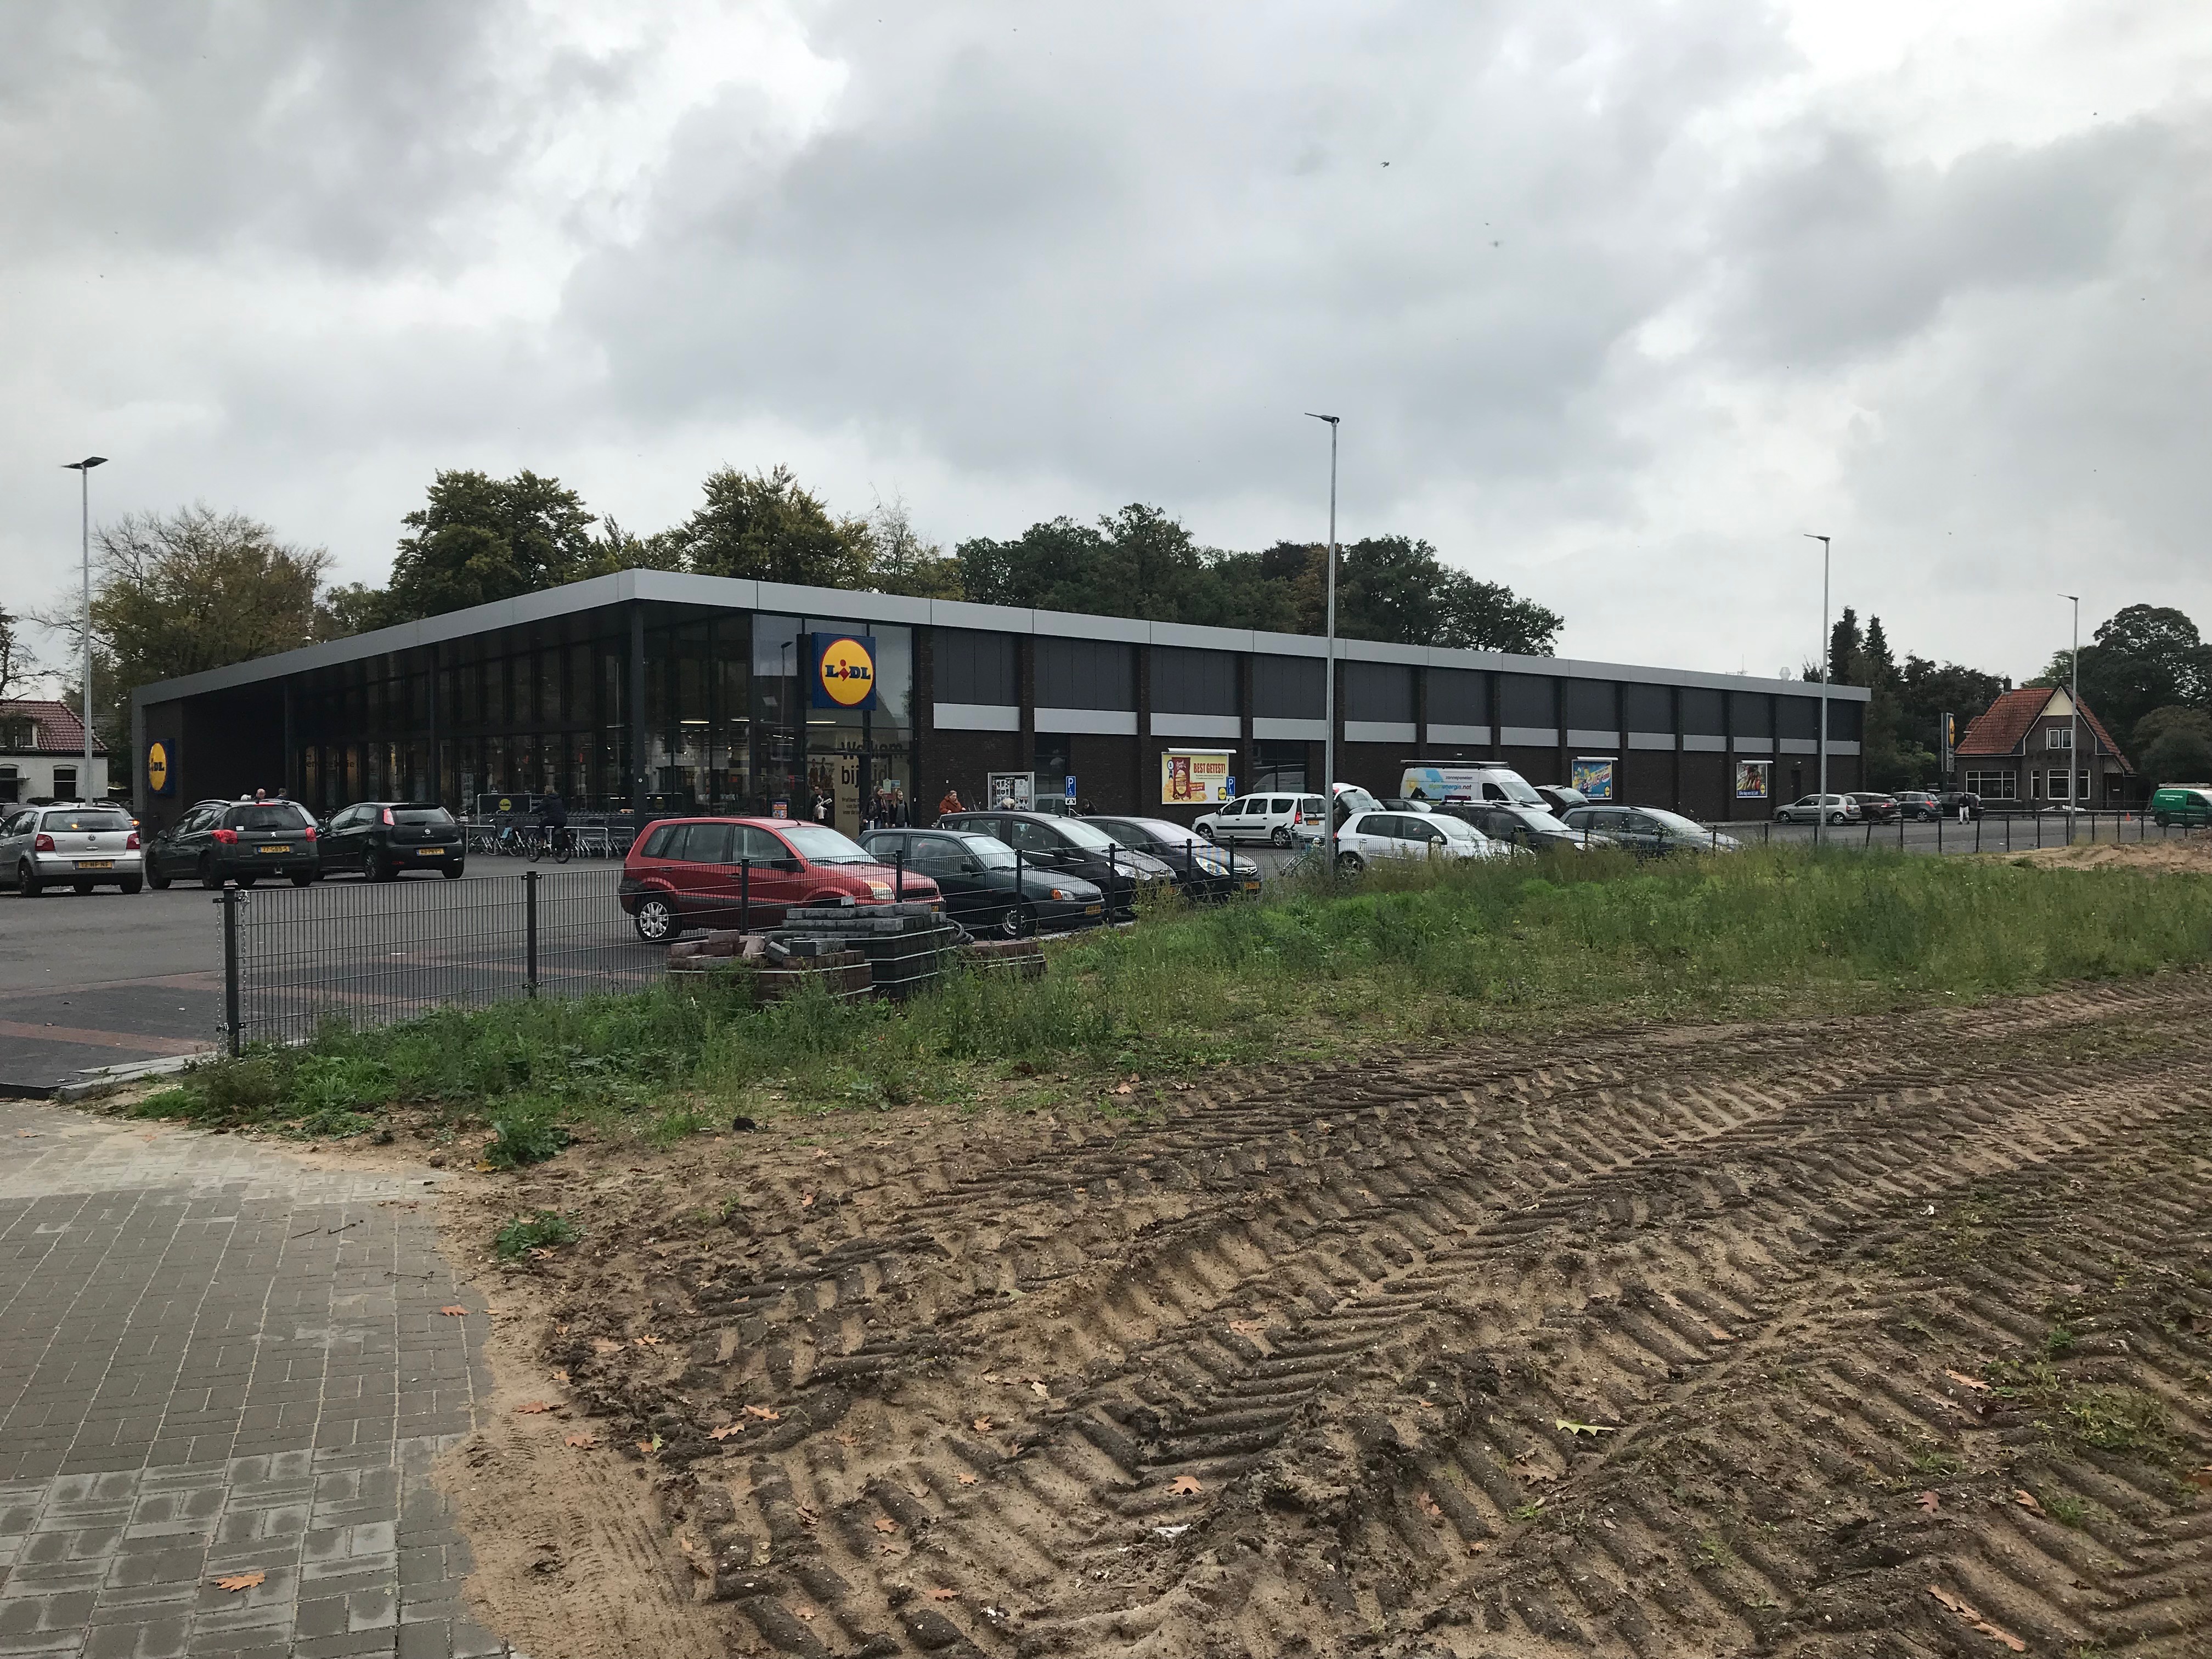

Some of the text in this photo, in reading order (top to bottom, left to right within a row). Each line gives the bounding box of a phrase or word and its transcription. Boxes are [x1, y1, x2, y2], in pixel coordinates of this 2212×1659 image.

[841, 741, 903, 759] Wekom
[1193, 763, 1226, 774] BEST GETEST!
[1068, 777, 1074, 788] P
[1228, 778, 1234, 788] P
